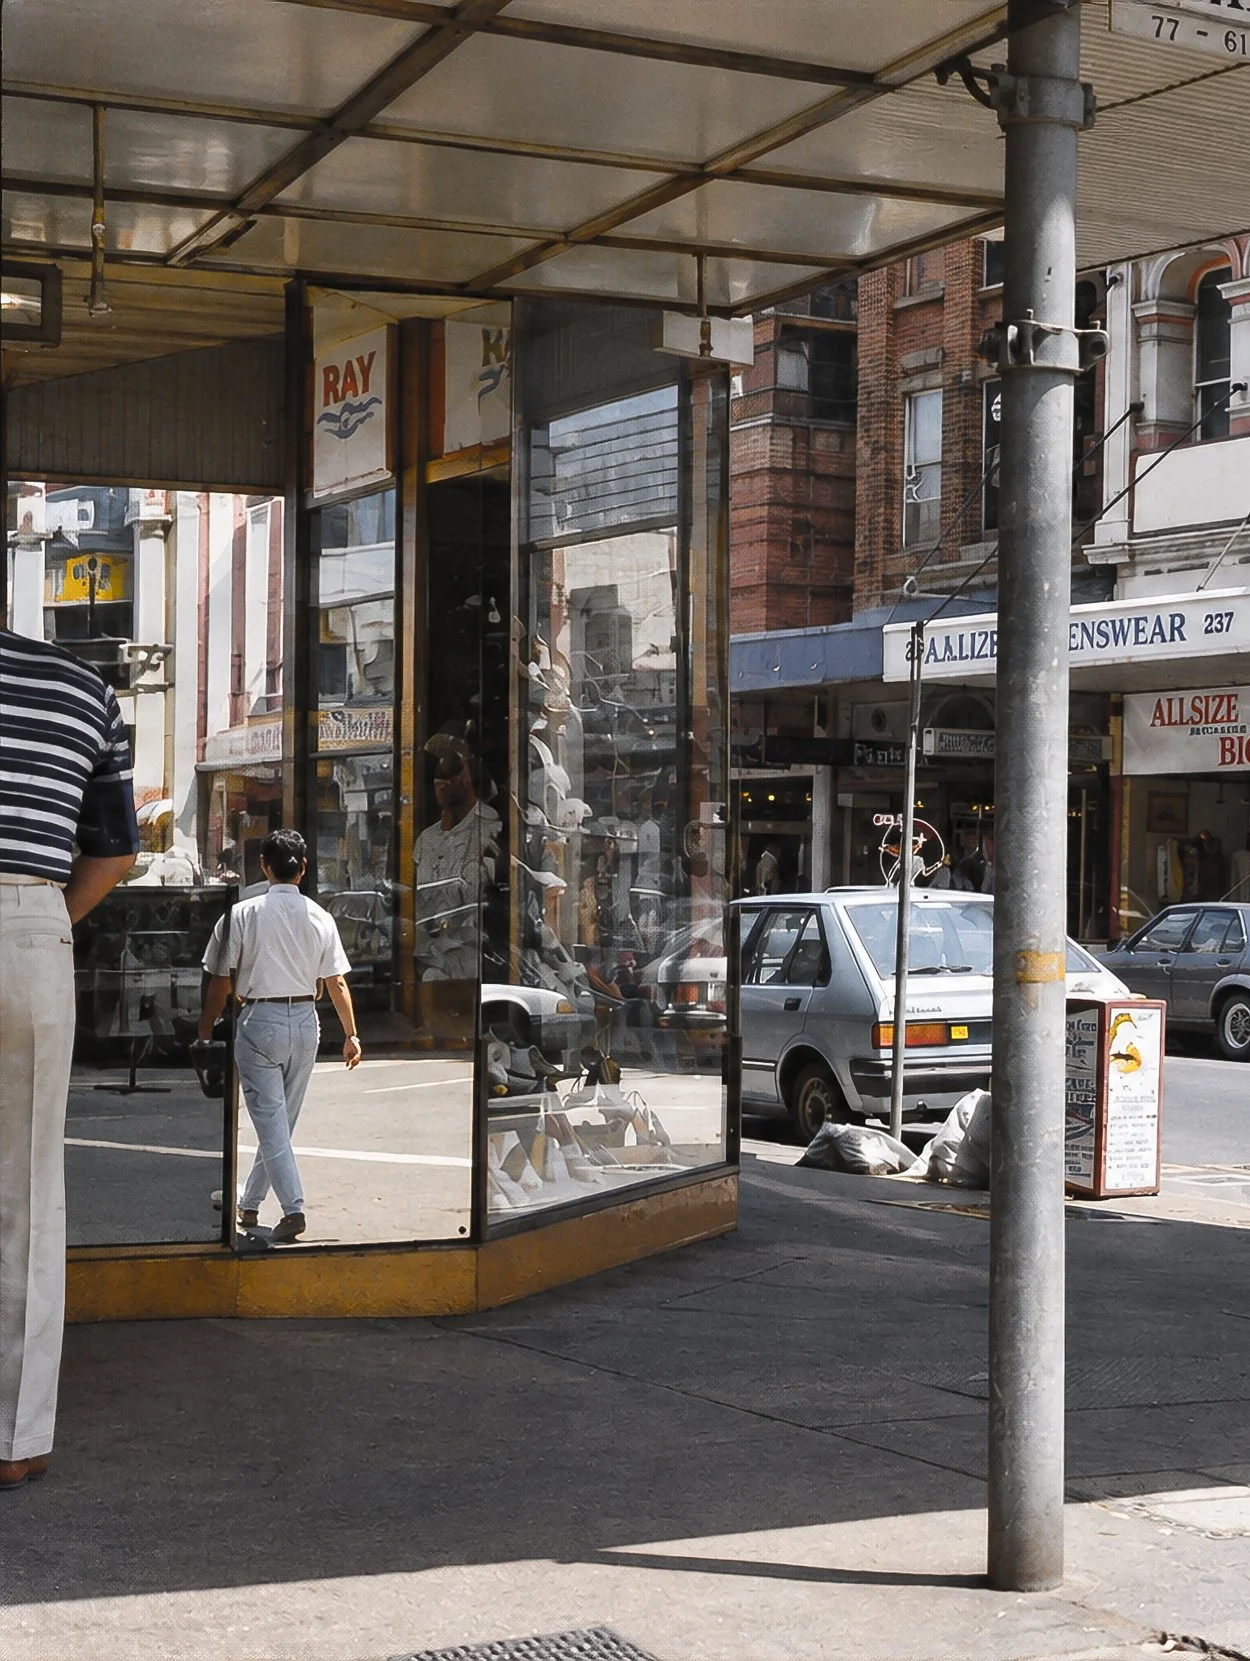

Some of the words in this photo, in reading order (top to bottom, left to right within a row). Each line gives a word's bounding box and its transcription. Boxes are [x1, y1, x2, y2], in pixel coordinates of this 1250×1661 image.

[1151, 15, 1180, 42] 77
[1224, 30, 1247, 56] 61
[322, 350, 377, 408] RAY
[1204, 612, 1234, 635] 237
[1149, 693, 1239, 727] ALLSIZE
